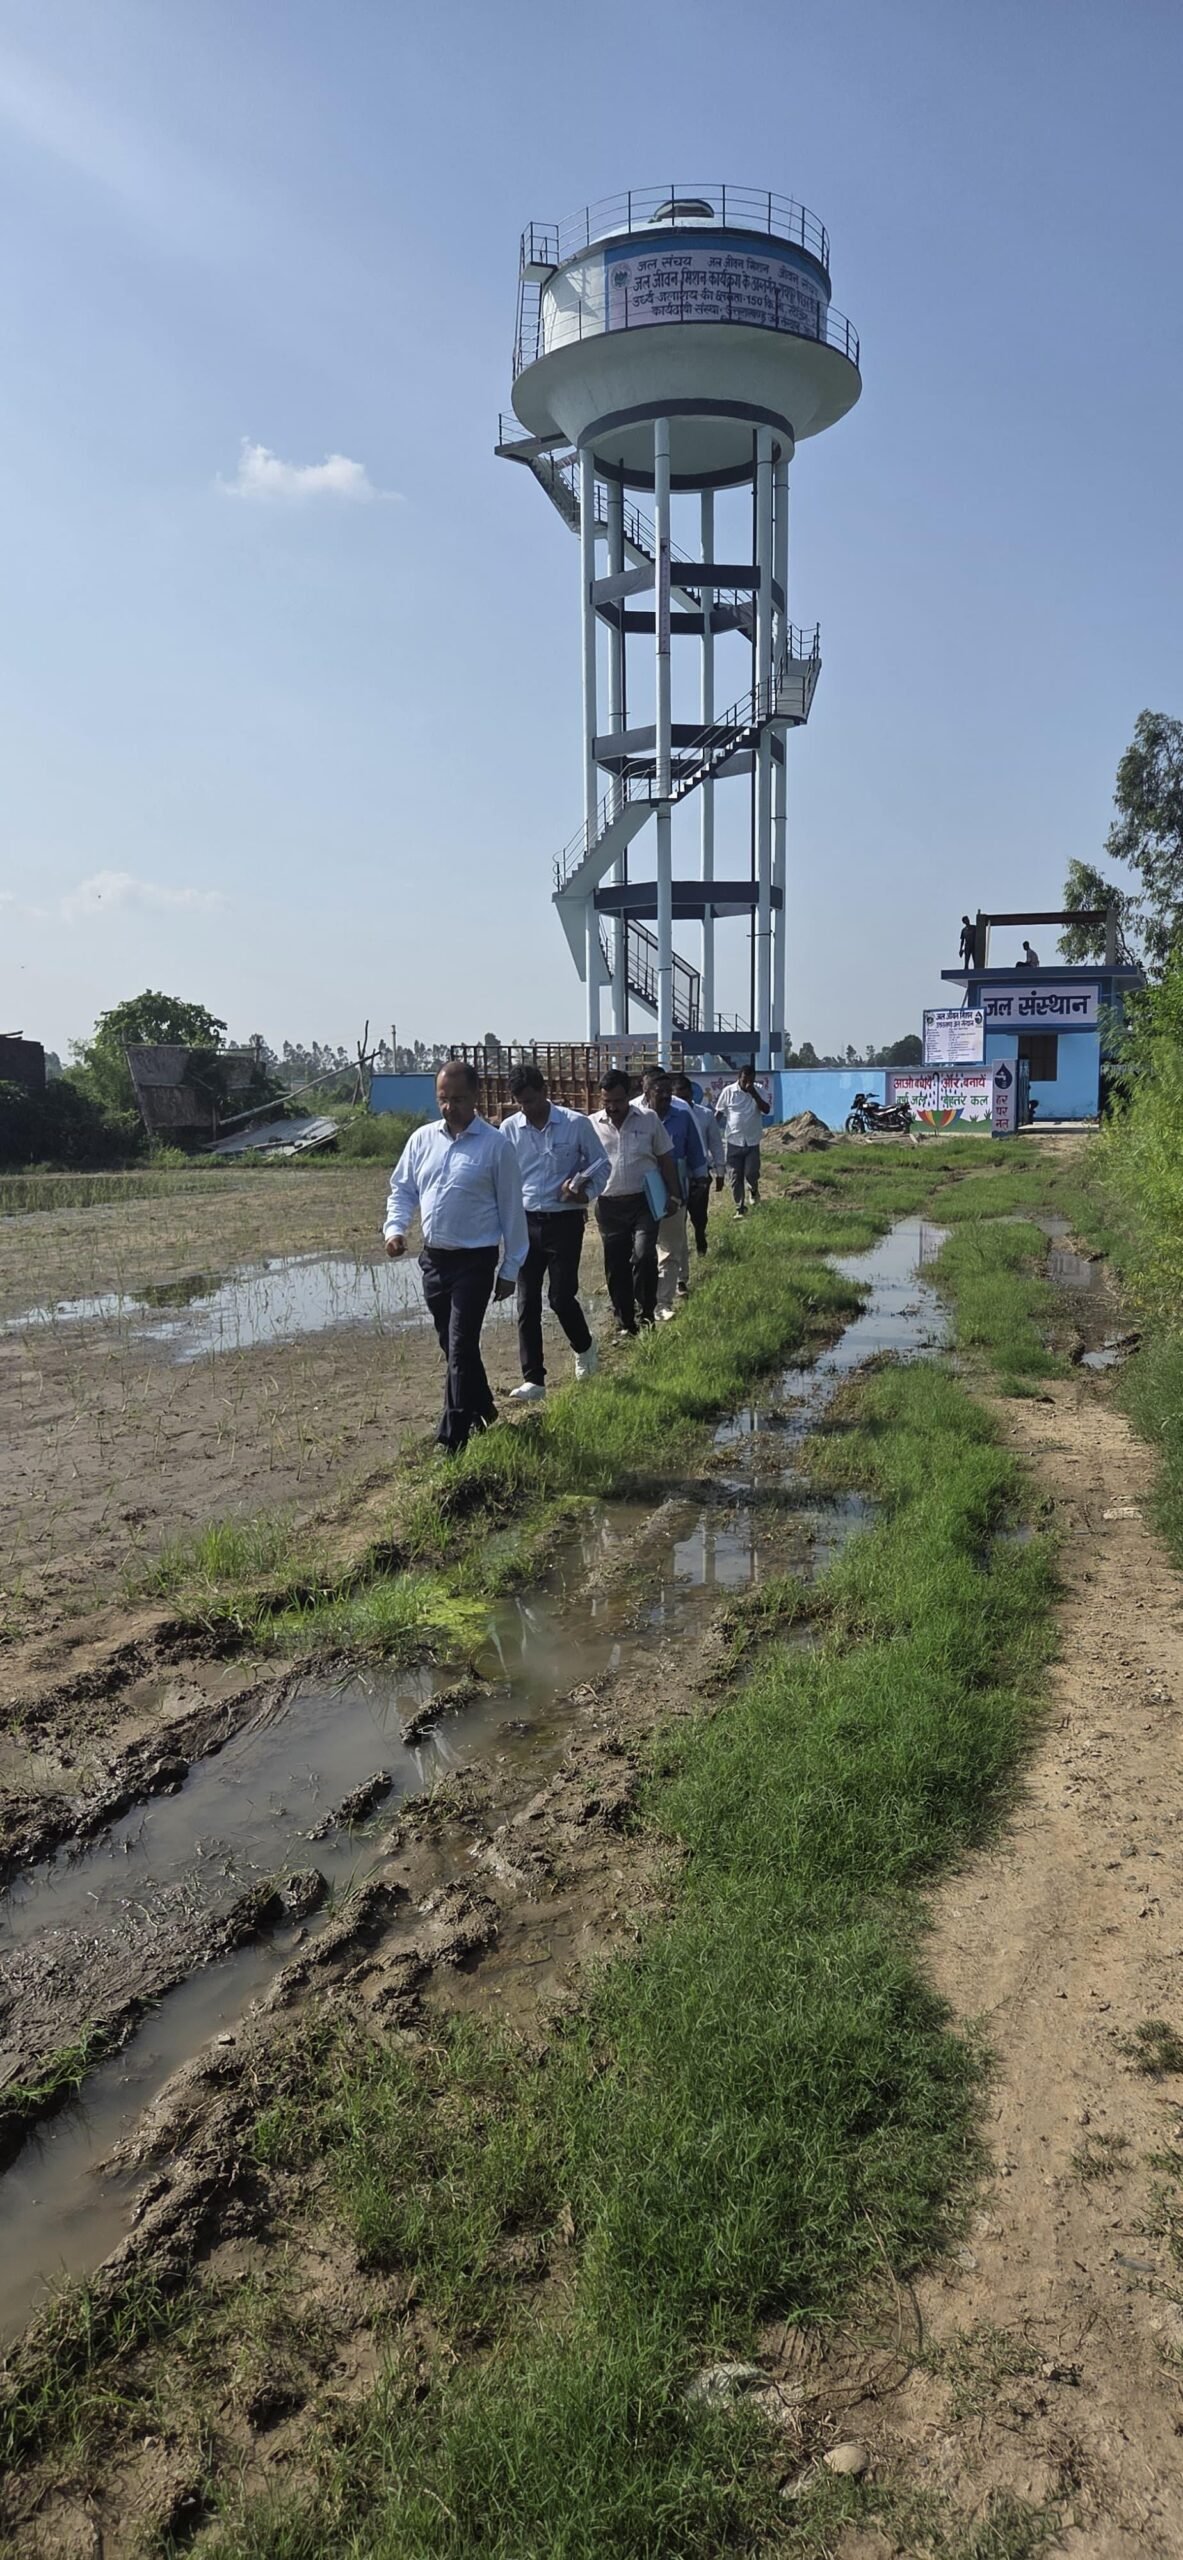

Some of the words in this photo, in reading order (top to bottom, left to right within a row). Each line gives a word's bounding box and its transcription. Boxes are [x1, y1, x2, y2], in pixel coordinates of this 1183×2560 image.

[637, 258, 657, 271] जल
[661, 254, 692, 268] संचय
[633, 274, 651, 291] जल
[652, 269, 678, 288] जीवन
[681, 267, 707, 286] मिशन
[709, 269, 741, 289] कार्यक्रम
[742, 271, 750, 290] के
[657, 290, 698, 302] जलाशय
[701, 287, 713, 301] की
[984, 998, 1014, 1016] जल
[1019, 990, 1091, 1016] संस्थान
[894, 1075, 913, 1089] आओ
[943, 1075, 960, 1089] और
[970, 1095, 989, 1106] कल
